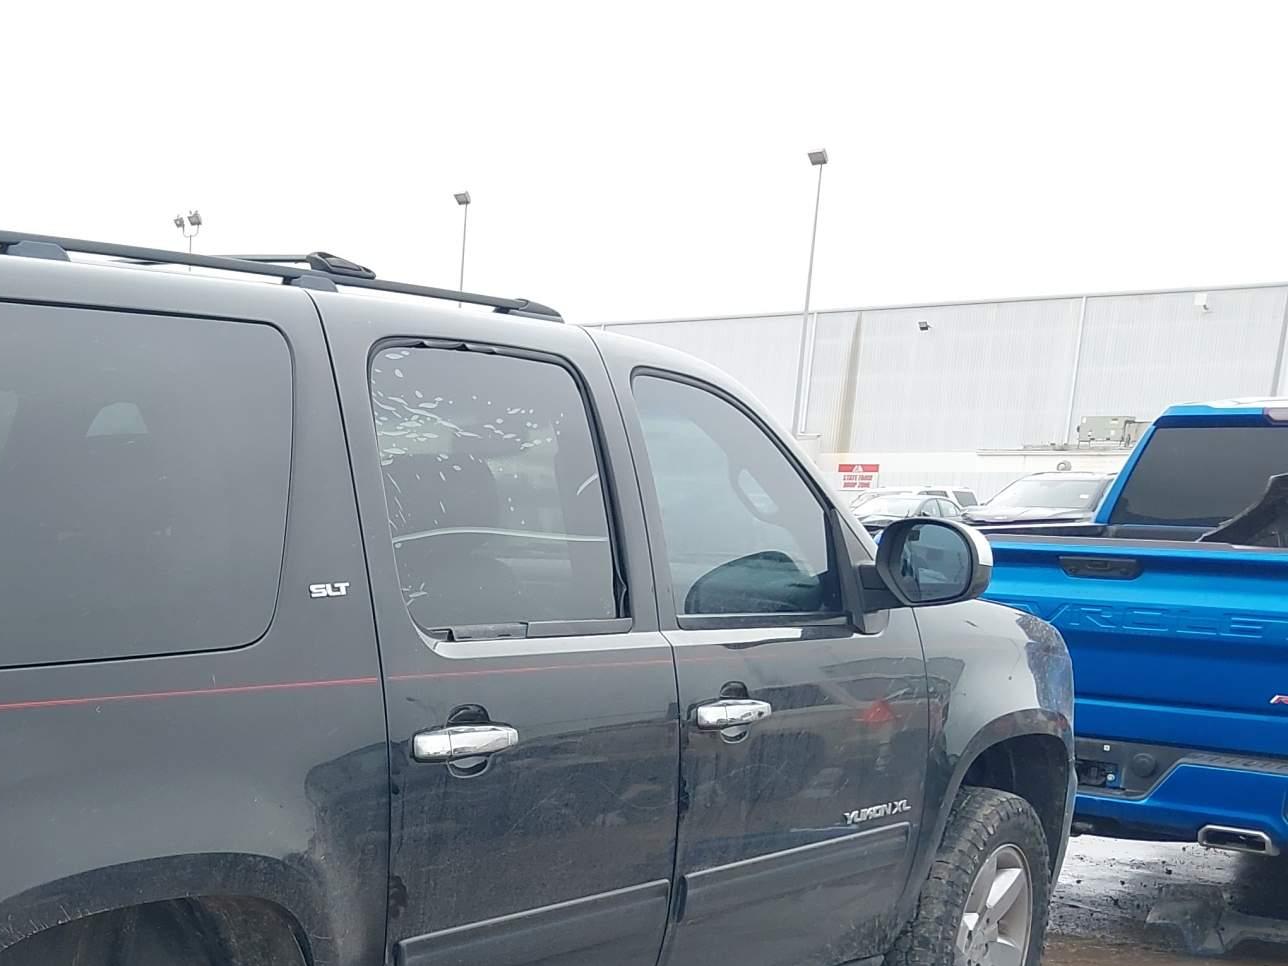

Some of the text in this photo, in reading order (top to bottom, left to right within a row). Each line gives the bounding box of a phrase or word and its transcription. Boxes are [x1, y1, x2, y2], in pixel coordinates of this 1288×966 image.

[309, 582, 350, 598] SLT
[843, 799, 912, 825] YUKON XL
